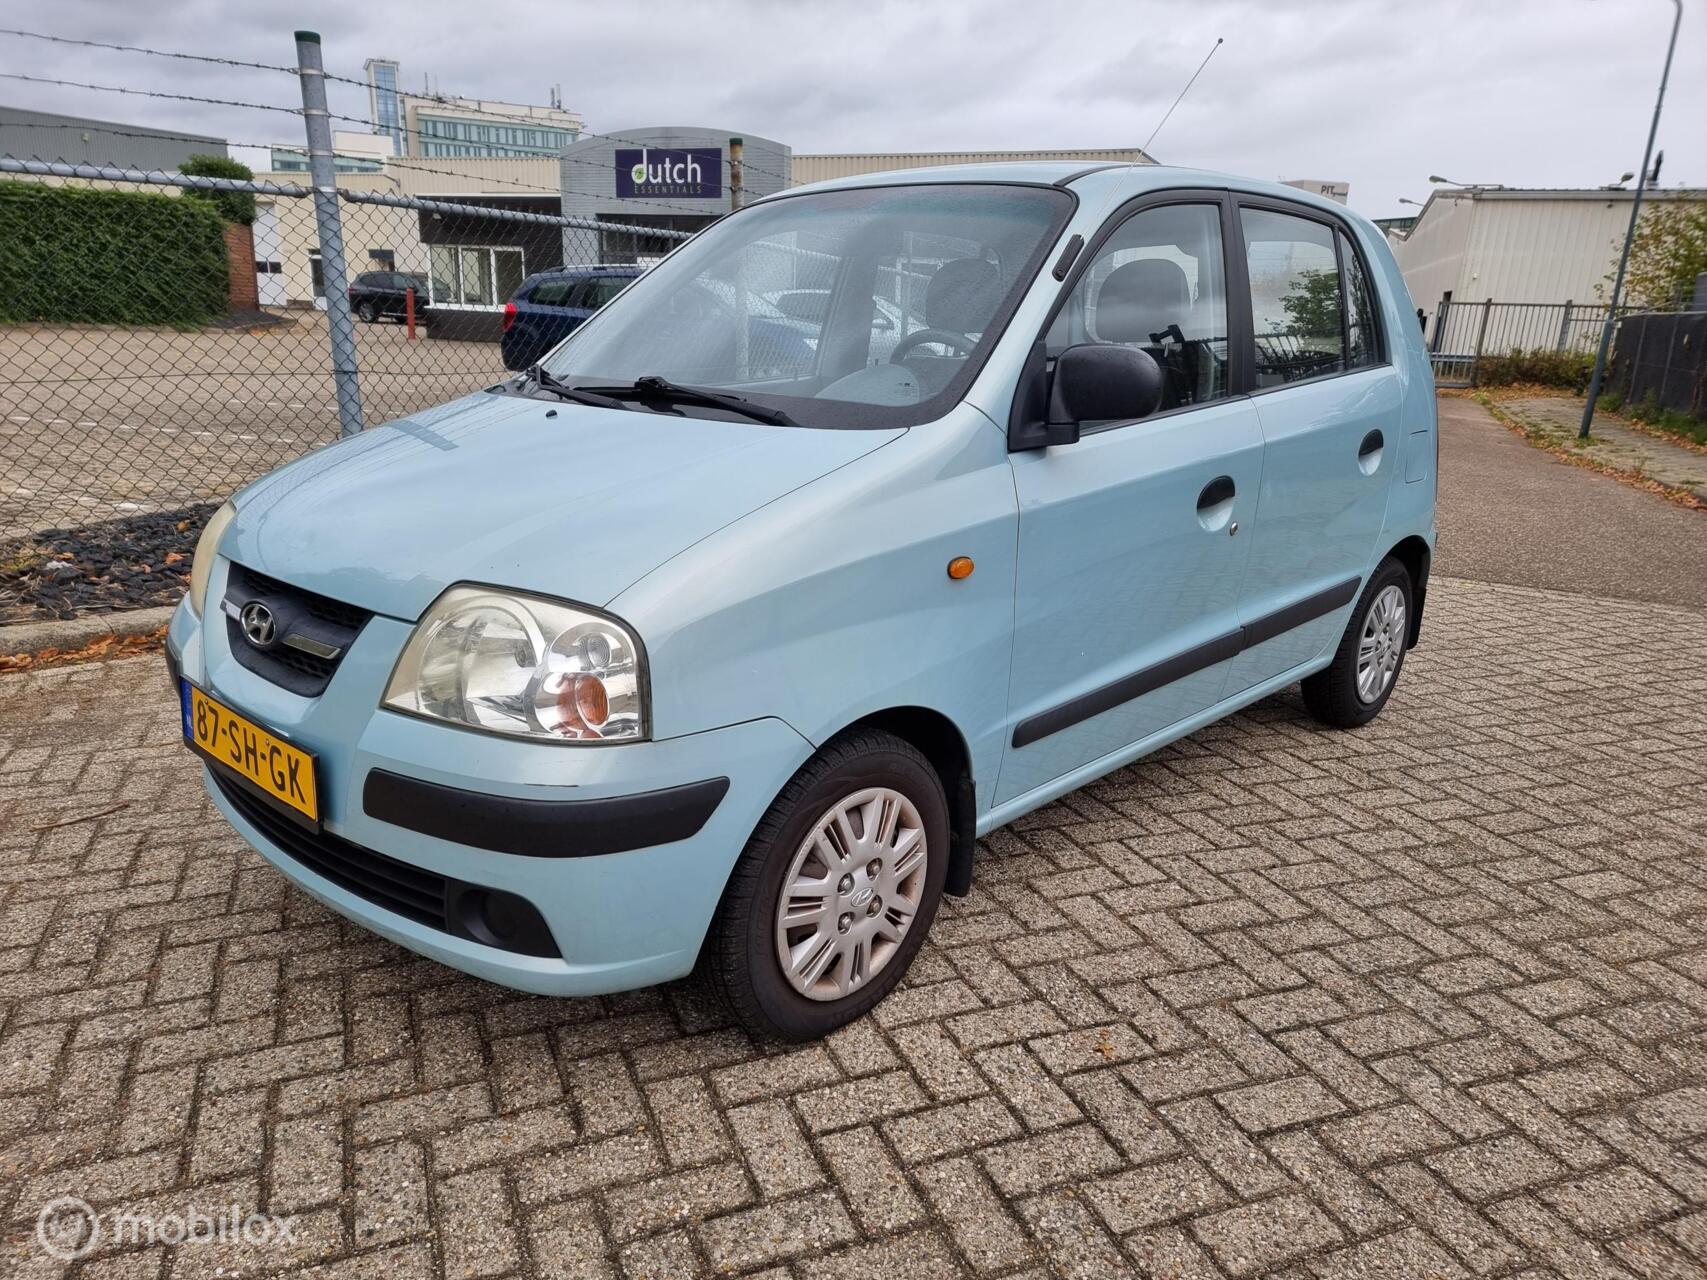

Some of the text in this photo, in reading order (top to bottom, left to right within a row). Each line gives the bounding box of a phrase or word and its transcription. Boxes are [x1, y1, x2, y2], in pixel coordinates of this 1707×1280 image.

[631, 148, 702, 184] dutch
[634, 185, 702, 194] ESSENTIALS
[197, 699, 306, 804] 87-SH-GK
